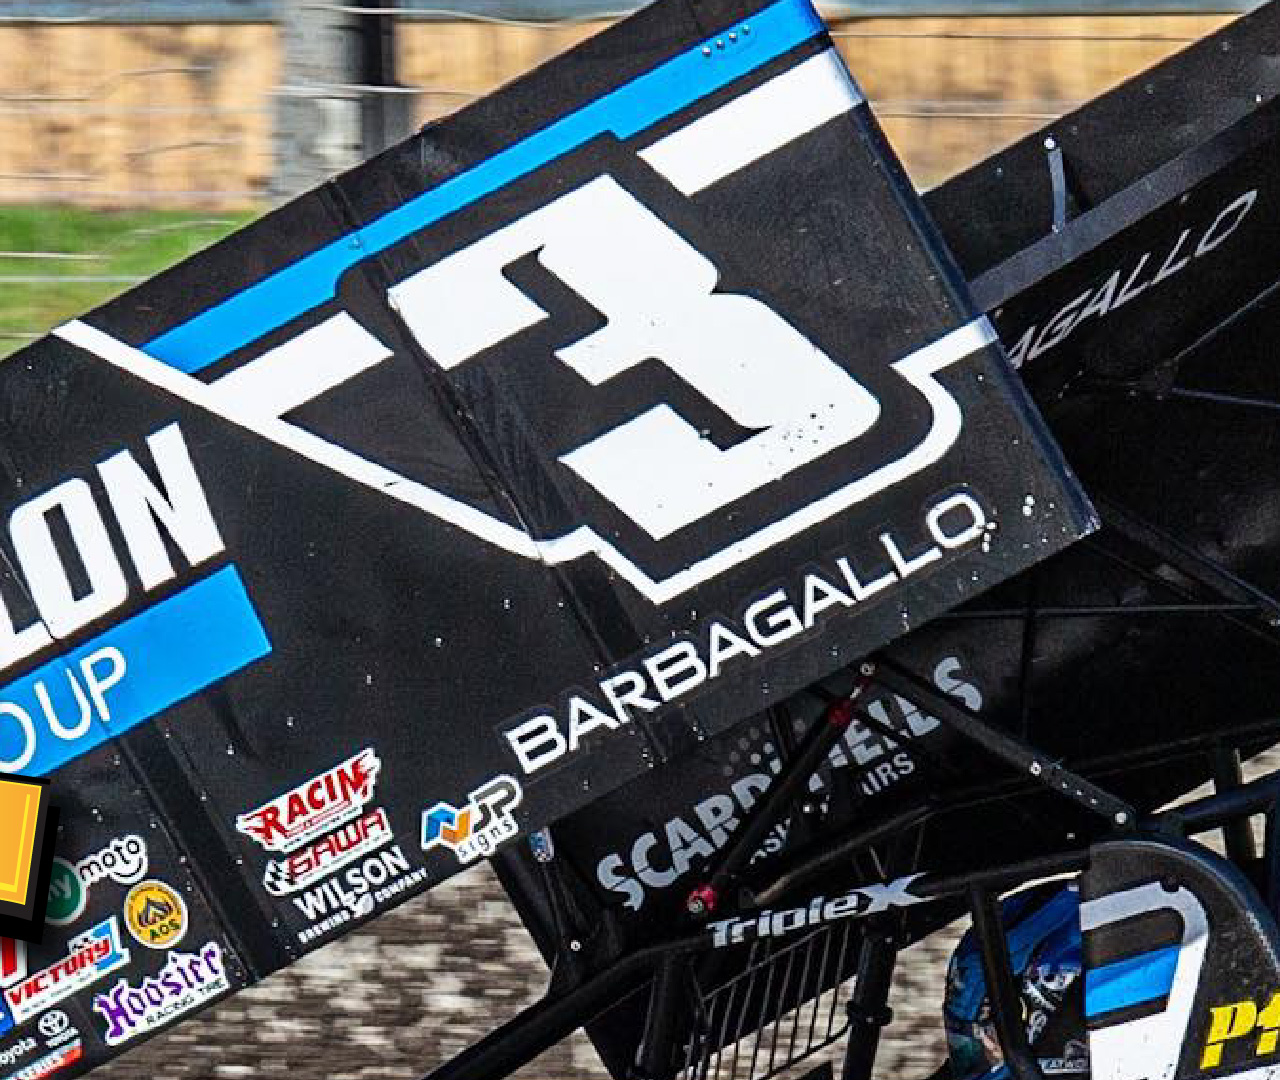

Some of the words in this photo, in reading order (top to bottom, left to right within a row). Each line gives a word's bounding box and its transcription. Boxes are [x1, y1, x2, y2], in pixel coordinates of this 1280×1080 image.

[387, 174, 881, 541] 3
[507, 492, 985, 774] BARBAGALLO
[293, 845, 410, 920] WILSON
[9, 939, 110, 1005] VICTORY
[96, 948, 220, 1038] Hoosier
